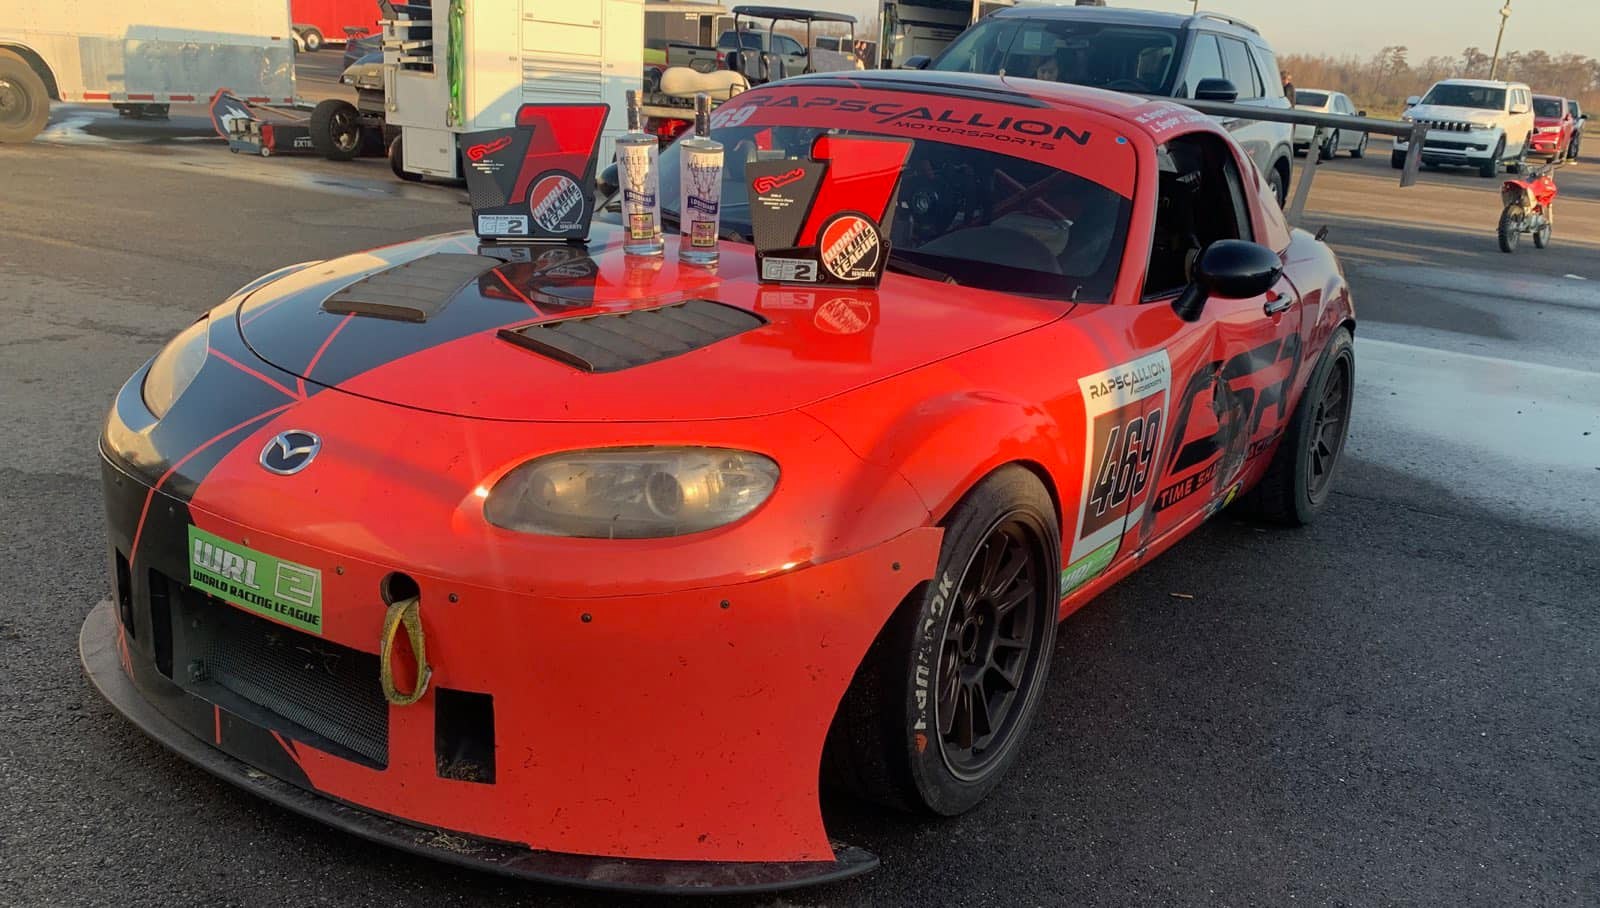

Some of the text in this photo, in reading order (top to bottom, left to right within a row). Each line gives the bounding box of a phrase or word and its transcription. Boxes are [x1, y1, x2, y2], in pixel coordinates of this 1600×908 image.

[737, 95, 1092, 146] RAPSCALLION
[894, 120, 1056, 150] MOTORSPORTS
[533, 178, 571, 218] WORLD
[544, 188, 582, 231] LEAGUE
[824, 220, 863, 263] WORLD
[829, 225, 873, 271] RACING
[834, 232, 877, 277] LEAGUE
[1089, 360, 1166, 400] RAPSCALLION
[1089, 407, 1163, 518] 469
[1160, 482, 1192, 509] TIME
[193, 537, 317, 607] WRL 2
[193, 569, 321, 626] WORLD RACING LEAGUE
